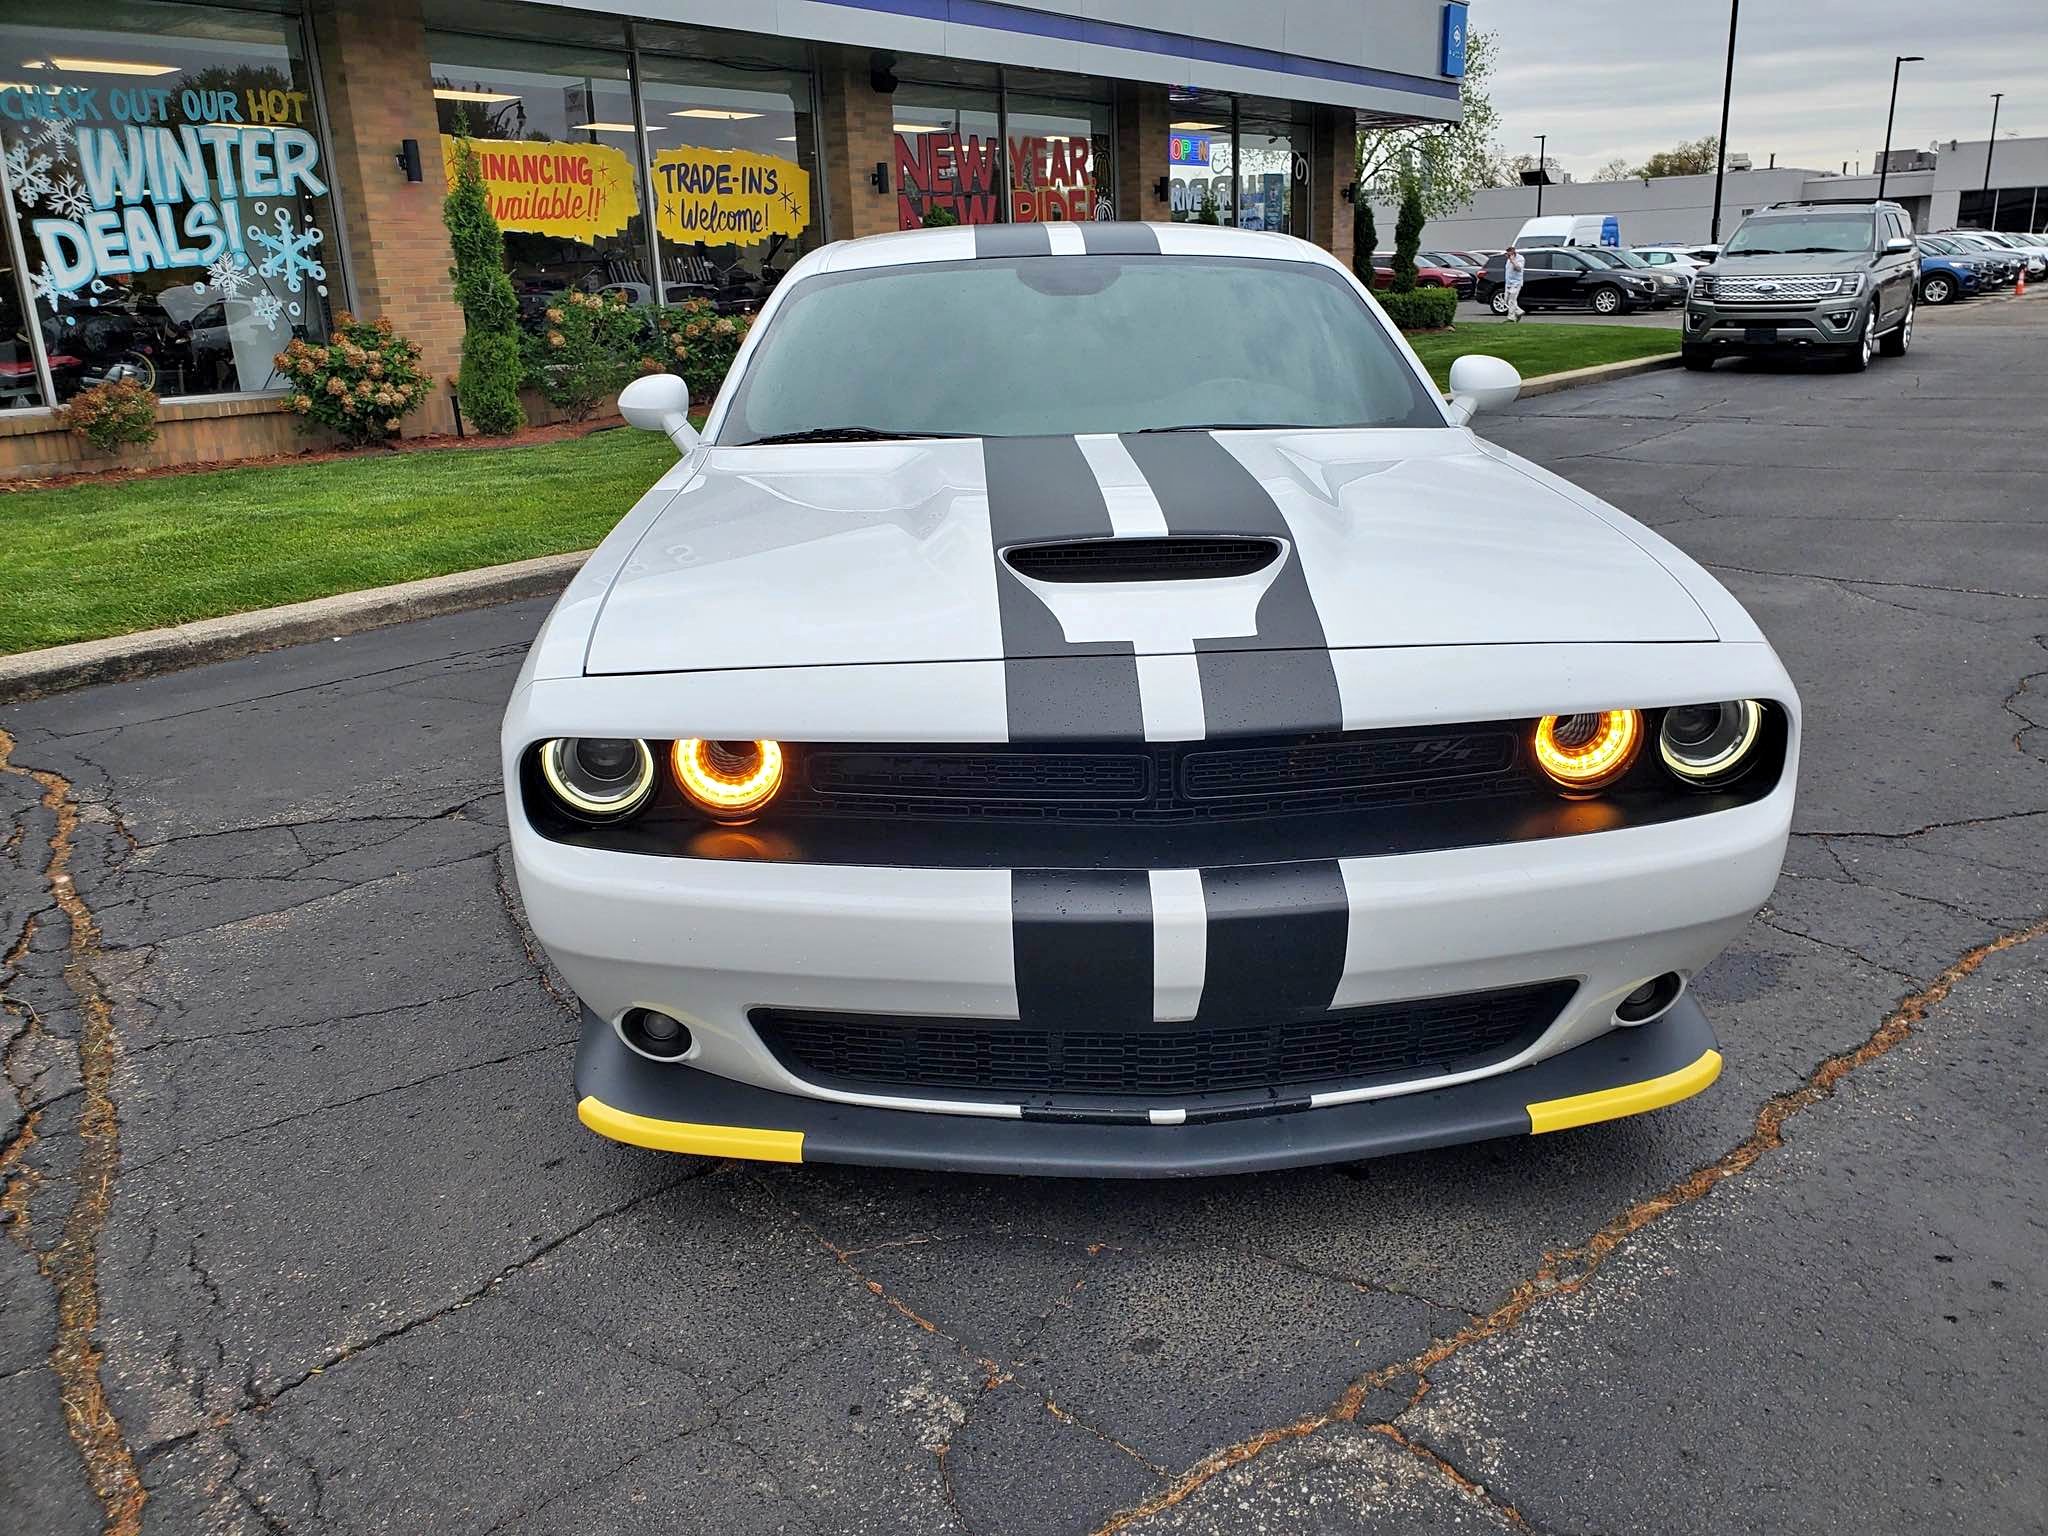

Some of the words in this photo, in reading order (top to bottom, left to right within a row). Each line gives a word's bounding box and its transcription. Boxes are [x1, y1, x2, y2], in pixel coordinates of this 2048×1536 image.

[0, 85, 103, 121] CHECK
[109, 88, 171, 122] OUT
[182, 89, 244, 123] OUR
[247, 88, 308, 125] HOT
[75, 124, 330, 210] WINTER
[894, 132, 998, 193] NEW
[1170, 138, 1209, 161] OPEN
[468, 153, 593, 186] INANCING
[659, 162, 779, 196] TRADE-IN'S
[680, 198, 769, 233] Welcome!
[31, 199, 250, 291] DEALS!
[1410, 736, 1480, 763] R/T
